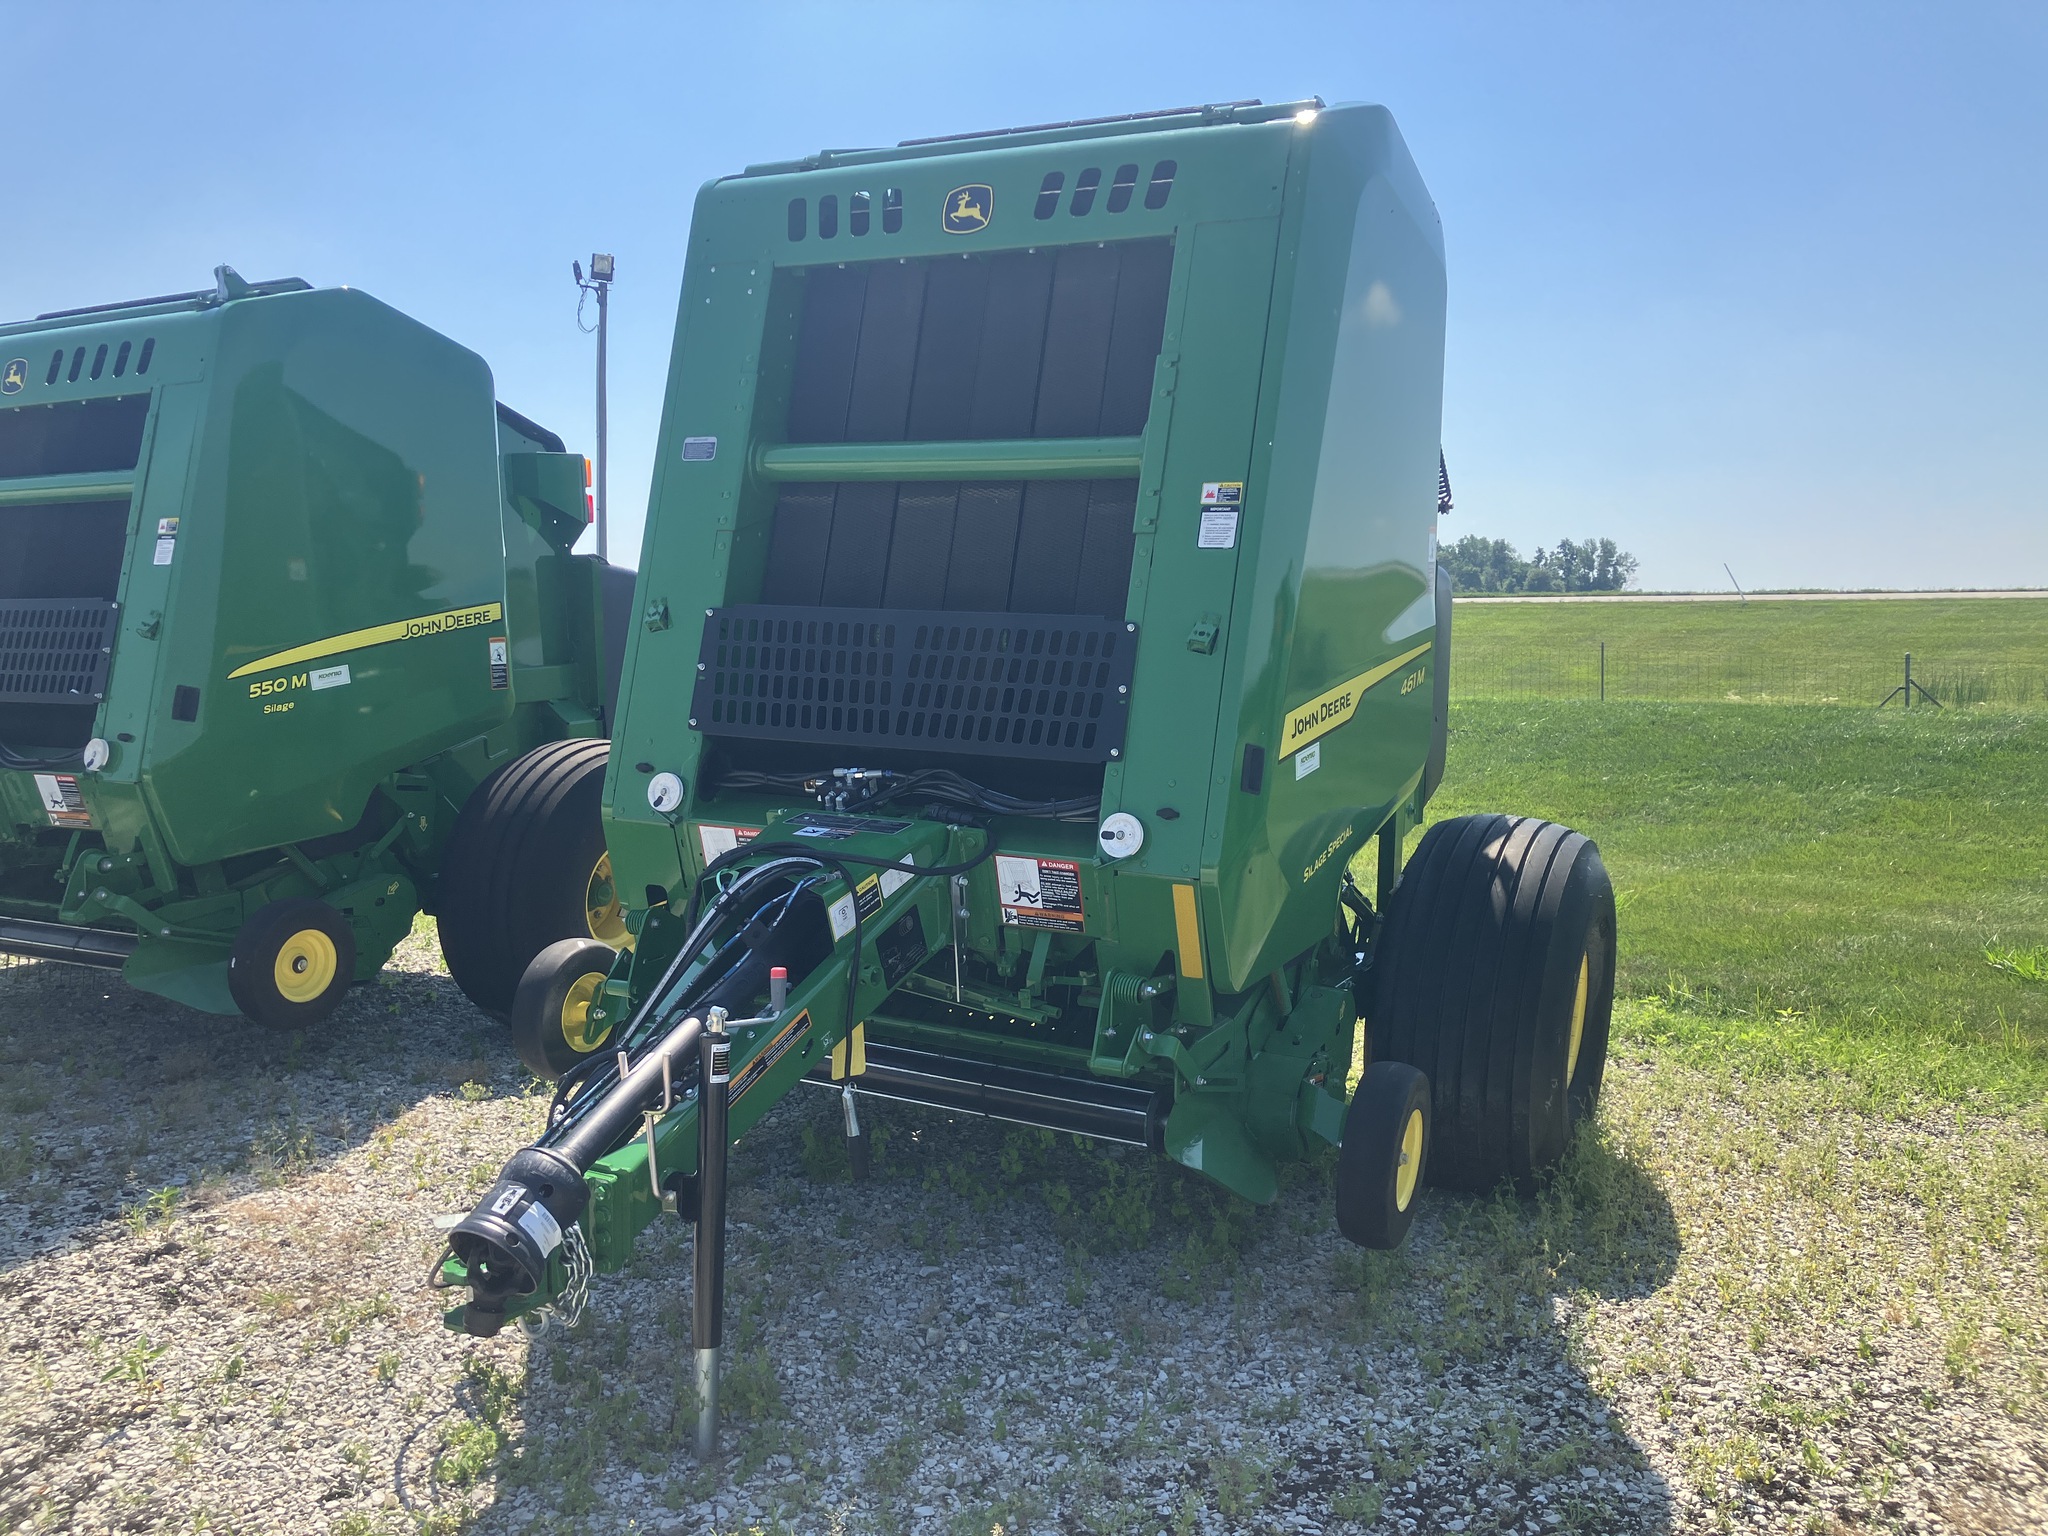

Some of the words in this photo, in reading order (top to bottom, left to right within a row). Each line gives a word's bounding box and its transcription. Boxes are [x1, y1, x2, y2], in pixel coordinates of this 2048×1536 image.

[401, 619, 441, 638] JOHN
[444, 610, 491, 629] DEERE
[249, 678, 288, 699] 550
[291, 672, 307, 690] M
[263, 701, 295, 715] Silage
[1291, 712, 1319, 740] JOHN
[1320, 691, 1352, 723] DEERE
[1326, 825, 1354, 858] SPECIAL
[1048, 861, 1074, 870] DANGER
